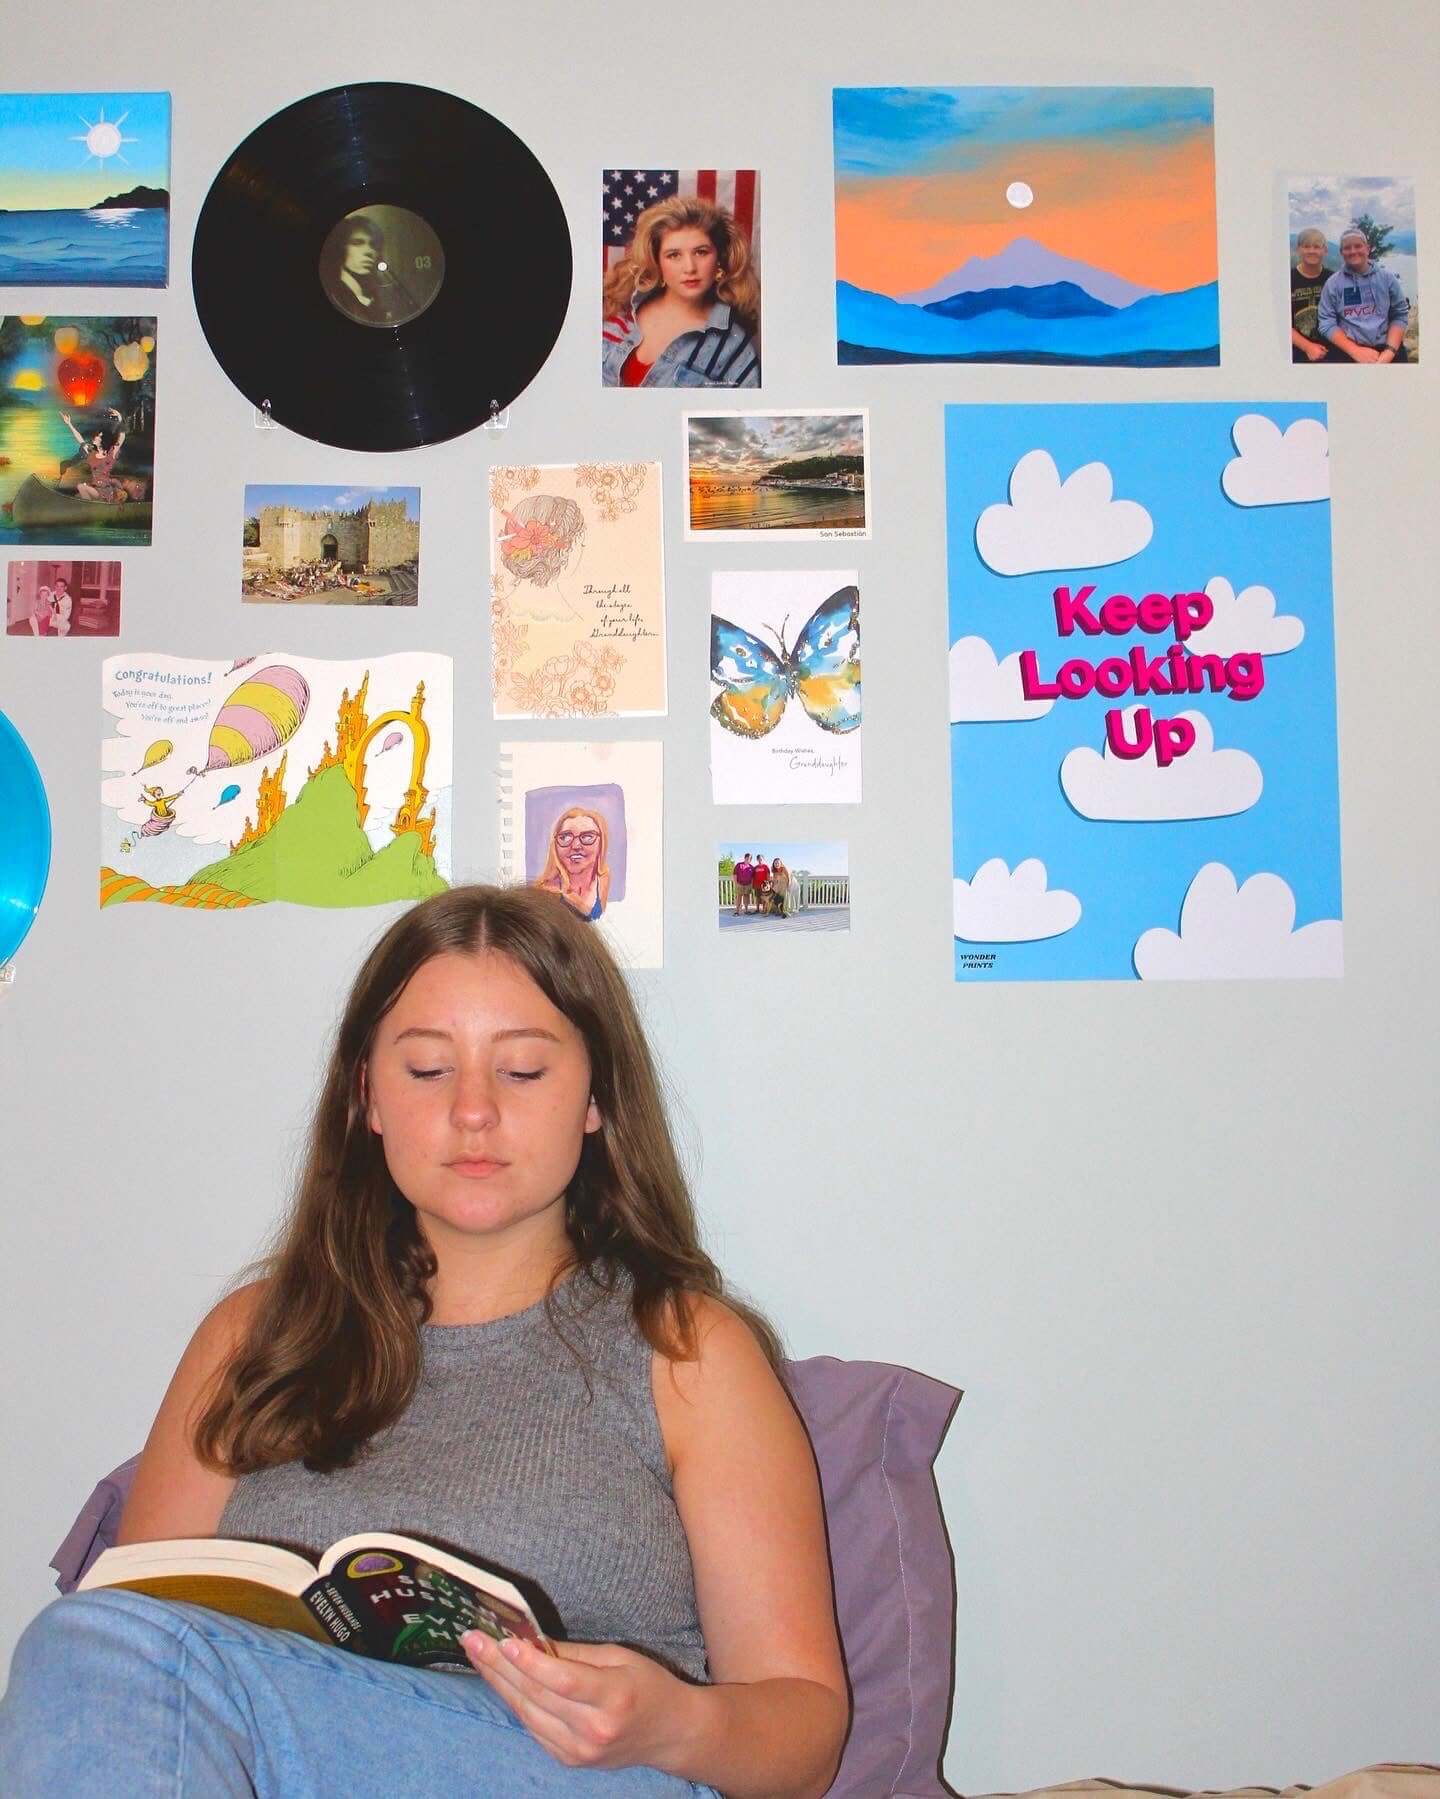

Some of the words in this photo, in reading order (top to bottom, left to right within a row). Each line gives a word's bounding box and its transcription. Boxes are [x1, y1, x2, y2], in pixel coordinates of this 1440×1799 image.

[415, 256, 432, 270] 03
[819, 530, 833, 538] San
[583, 584, 617, 599] Through
[618, 584, 631, 594] all
[595, 599, 606, 609] the
[607, 601, 632, 613] stages
[1053, 586, 1214, 641] Keep
[600, 614, 608, 628] of
[609, 618, 627, 628] your
[115, 670, 212, 685] Congratulations!
[1019, 645, 1265, 701] Looking
[112, 688, 133, 698] Today
[141, 689, 157, 699] your
[146, 701, 158, 711] off
[168, 703, 187, 714] great
[163, 715, 174, 725] off
[175, 715, 189, 725] and
[1105, 708, 1195, 768] Up
[771, 747, 794, 755] Birthday
[789, 754, 848, 777] Granddaughter
[309, 1590, 337, 1623] EVELYN
[329, 1616, 351, 1643] HUGO
